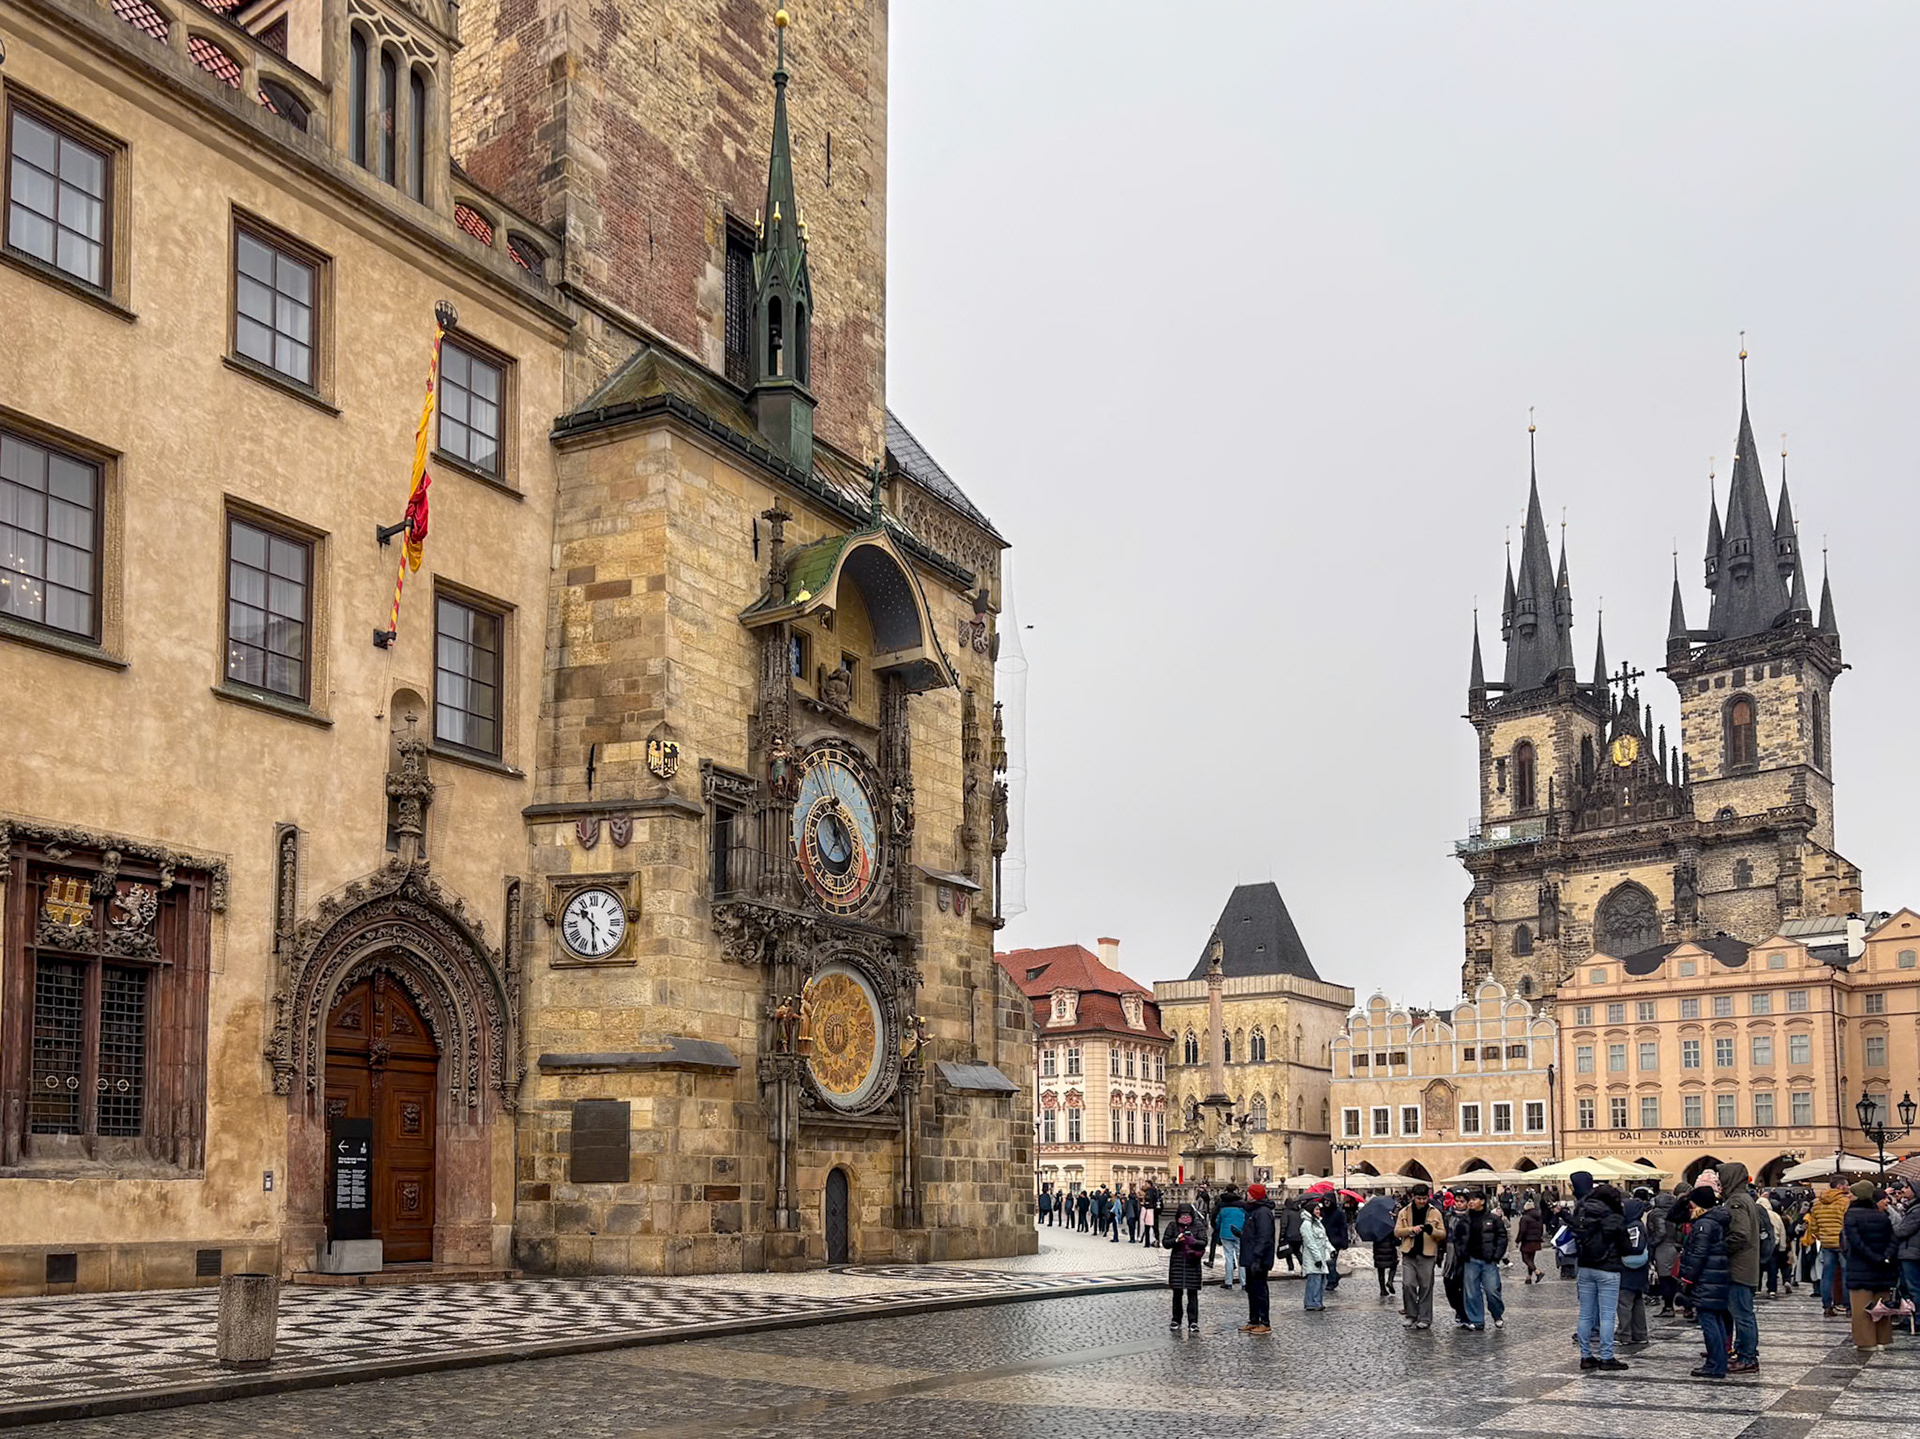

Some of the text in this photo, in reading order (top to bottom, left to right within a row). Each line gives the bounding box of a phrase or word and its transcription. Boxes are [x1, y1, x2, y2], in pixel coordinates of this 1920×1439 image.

[589, 896, 599, 907] XII
[1619, 1129, 1769, 1140] DALI SAUDEK WARHOL
